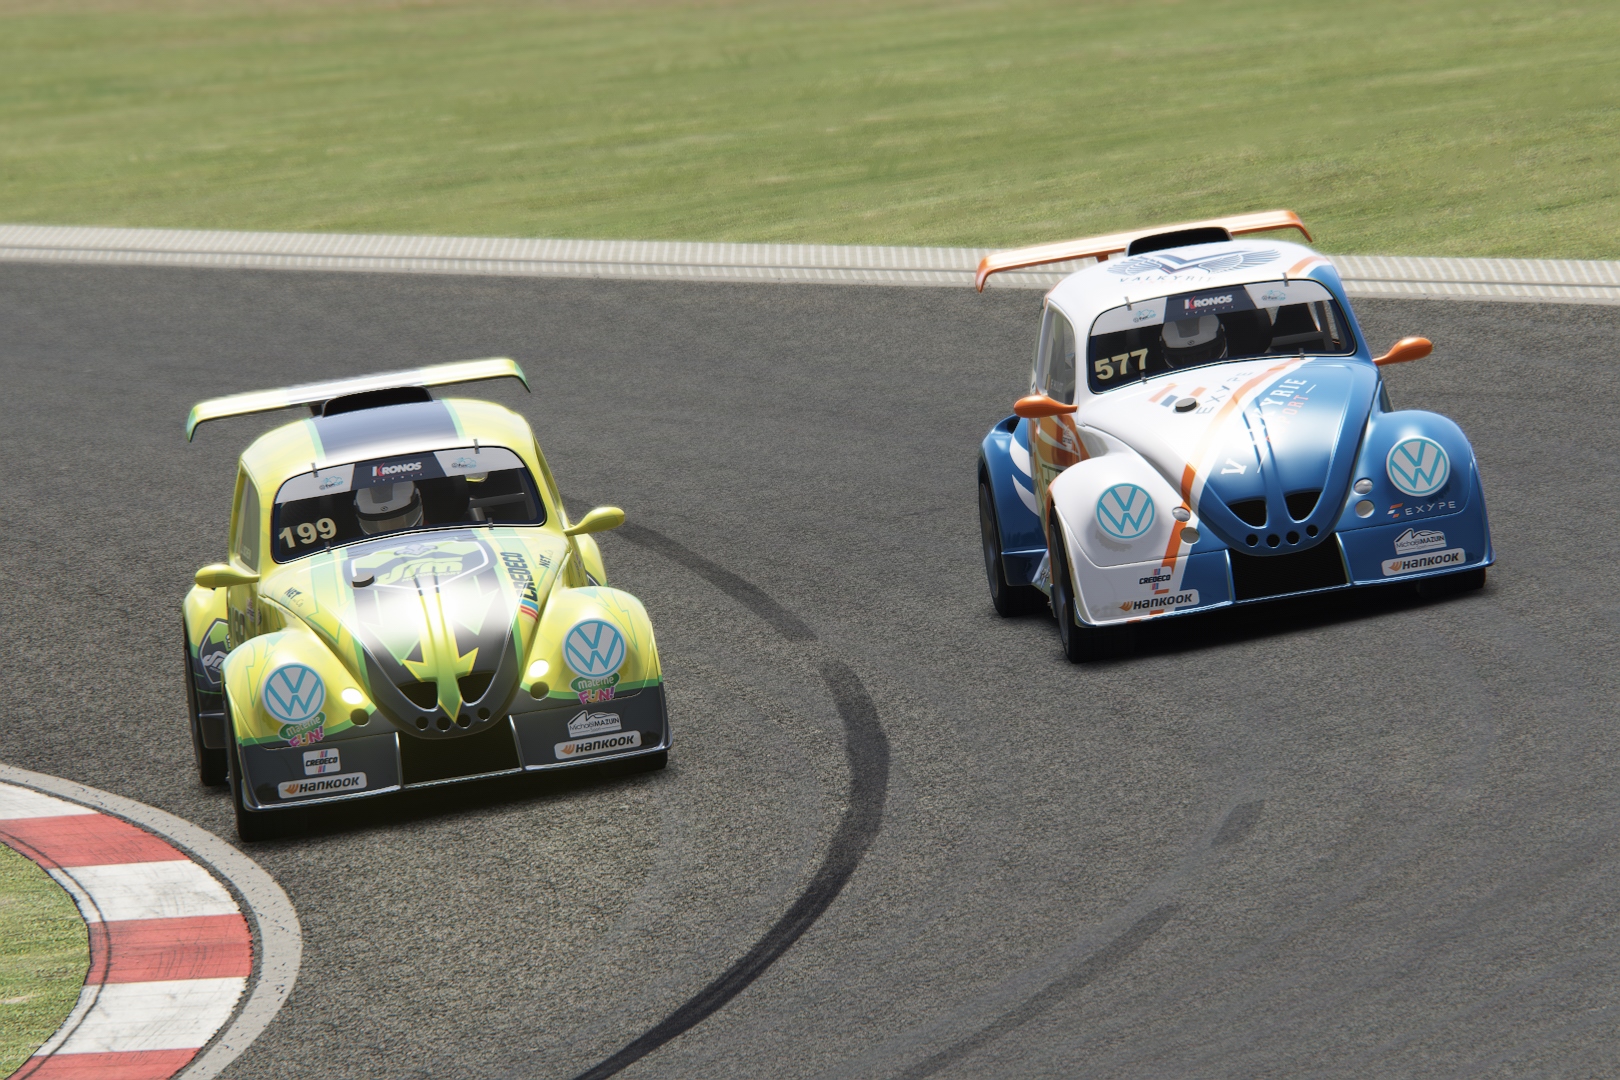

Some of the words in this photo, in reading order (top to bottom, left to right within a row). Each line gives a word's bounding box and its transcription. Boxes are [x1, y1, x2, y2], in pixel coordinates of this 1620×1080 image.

[1184, 295, 1233, 310] KRONOS
[1094, 348, 1149, 380] 577
[372, 462, 422, 477] KRONOS
[1405, 500, 1457, 516] EXYPE
[279, 517, 337, 548] 199
[1402, 552, 1459, 570] HANKOOK
[1138, 574, 1171, 585] CREDECO
[1133, 593, 1193, 610] HANKOOK
[578, 686, 615, 705] FUN!
[289, 726, 325, 748] FUN!
[576, 735, 635, 753] HANKOOK
[305, 756, 339, 767] CREDECO
[299, 776, 360, 793] HANKOOK
